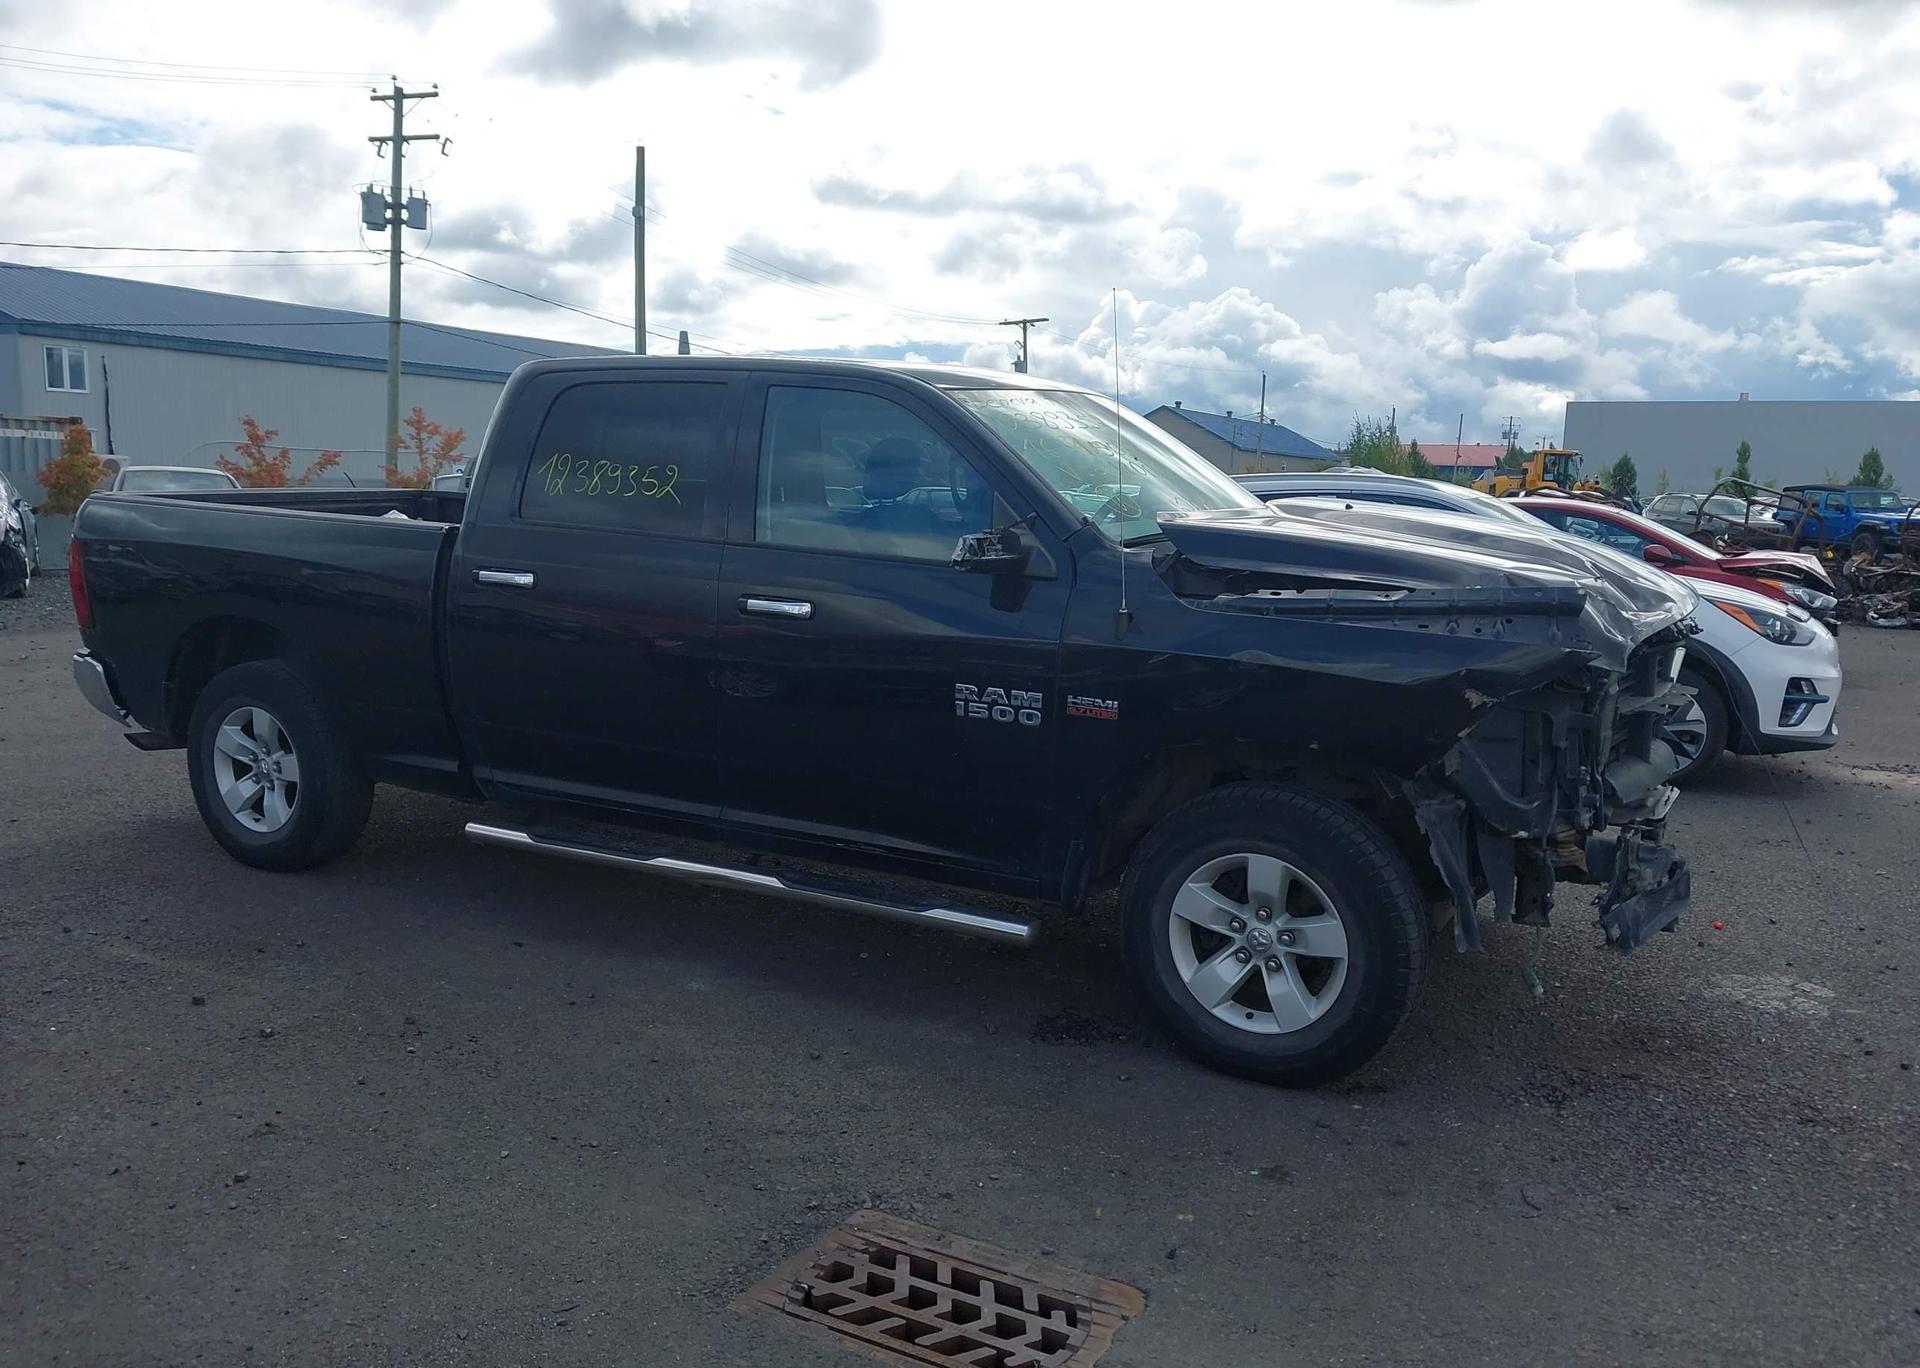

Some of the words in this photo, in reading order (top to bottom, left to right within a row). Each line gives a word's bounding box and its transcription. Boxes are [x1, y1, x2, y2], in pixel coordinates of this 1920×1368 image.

[538, 453, 681, 504] 12389352
[955, 683, 1043, 709] RAM
[1067, 695, 1119, 711] HEMI
[955, 701, 1042, 726] 1500
